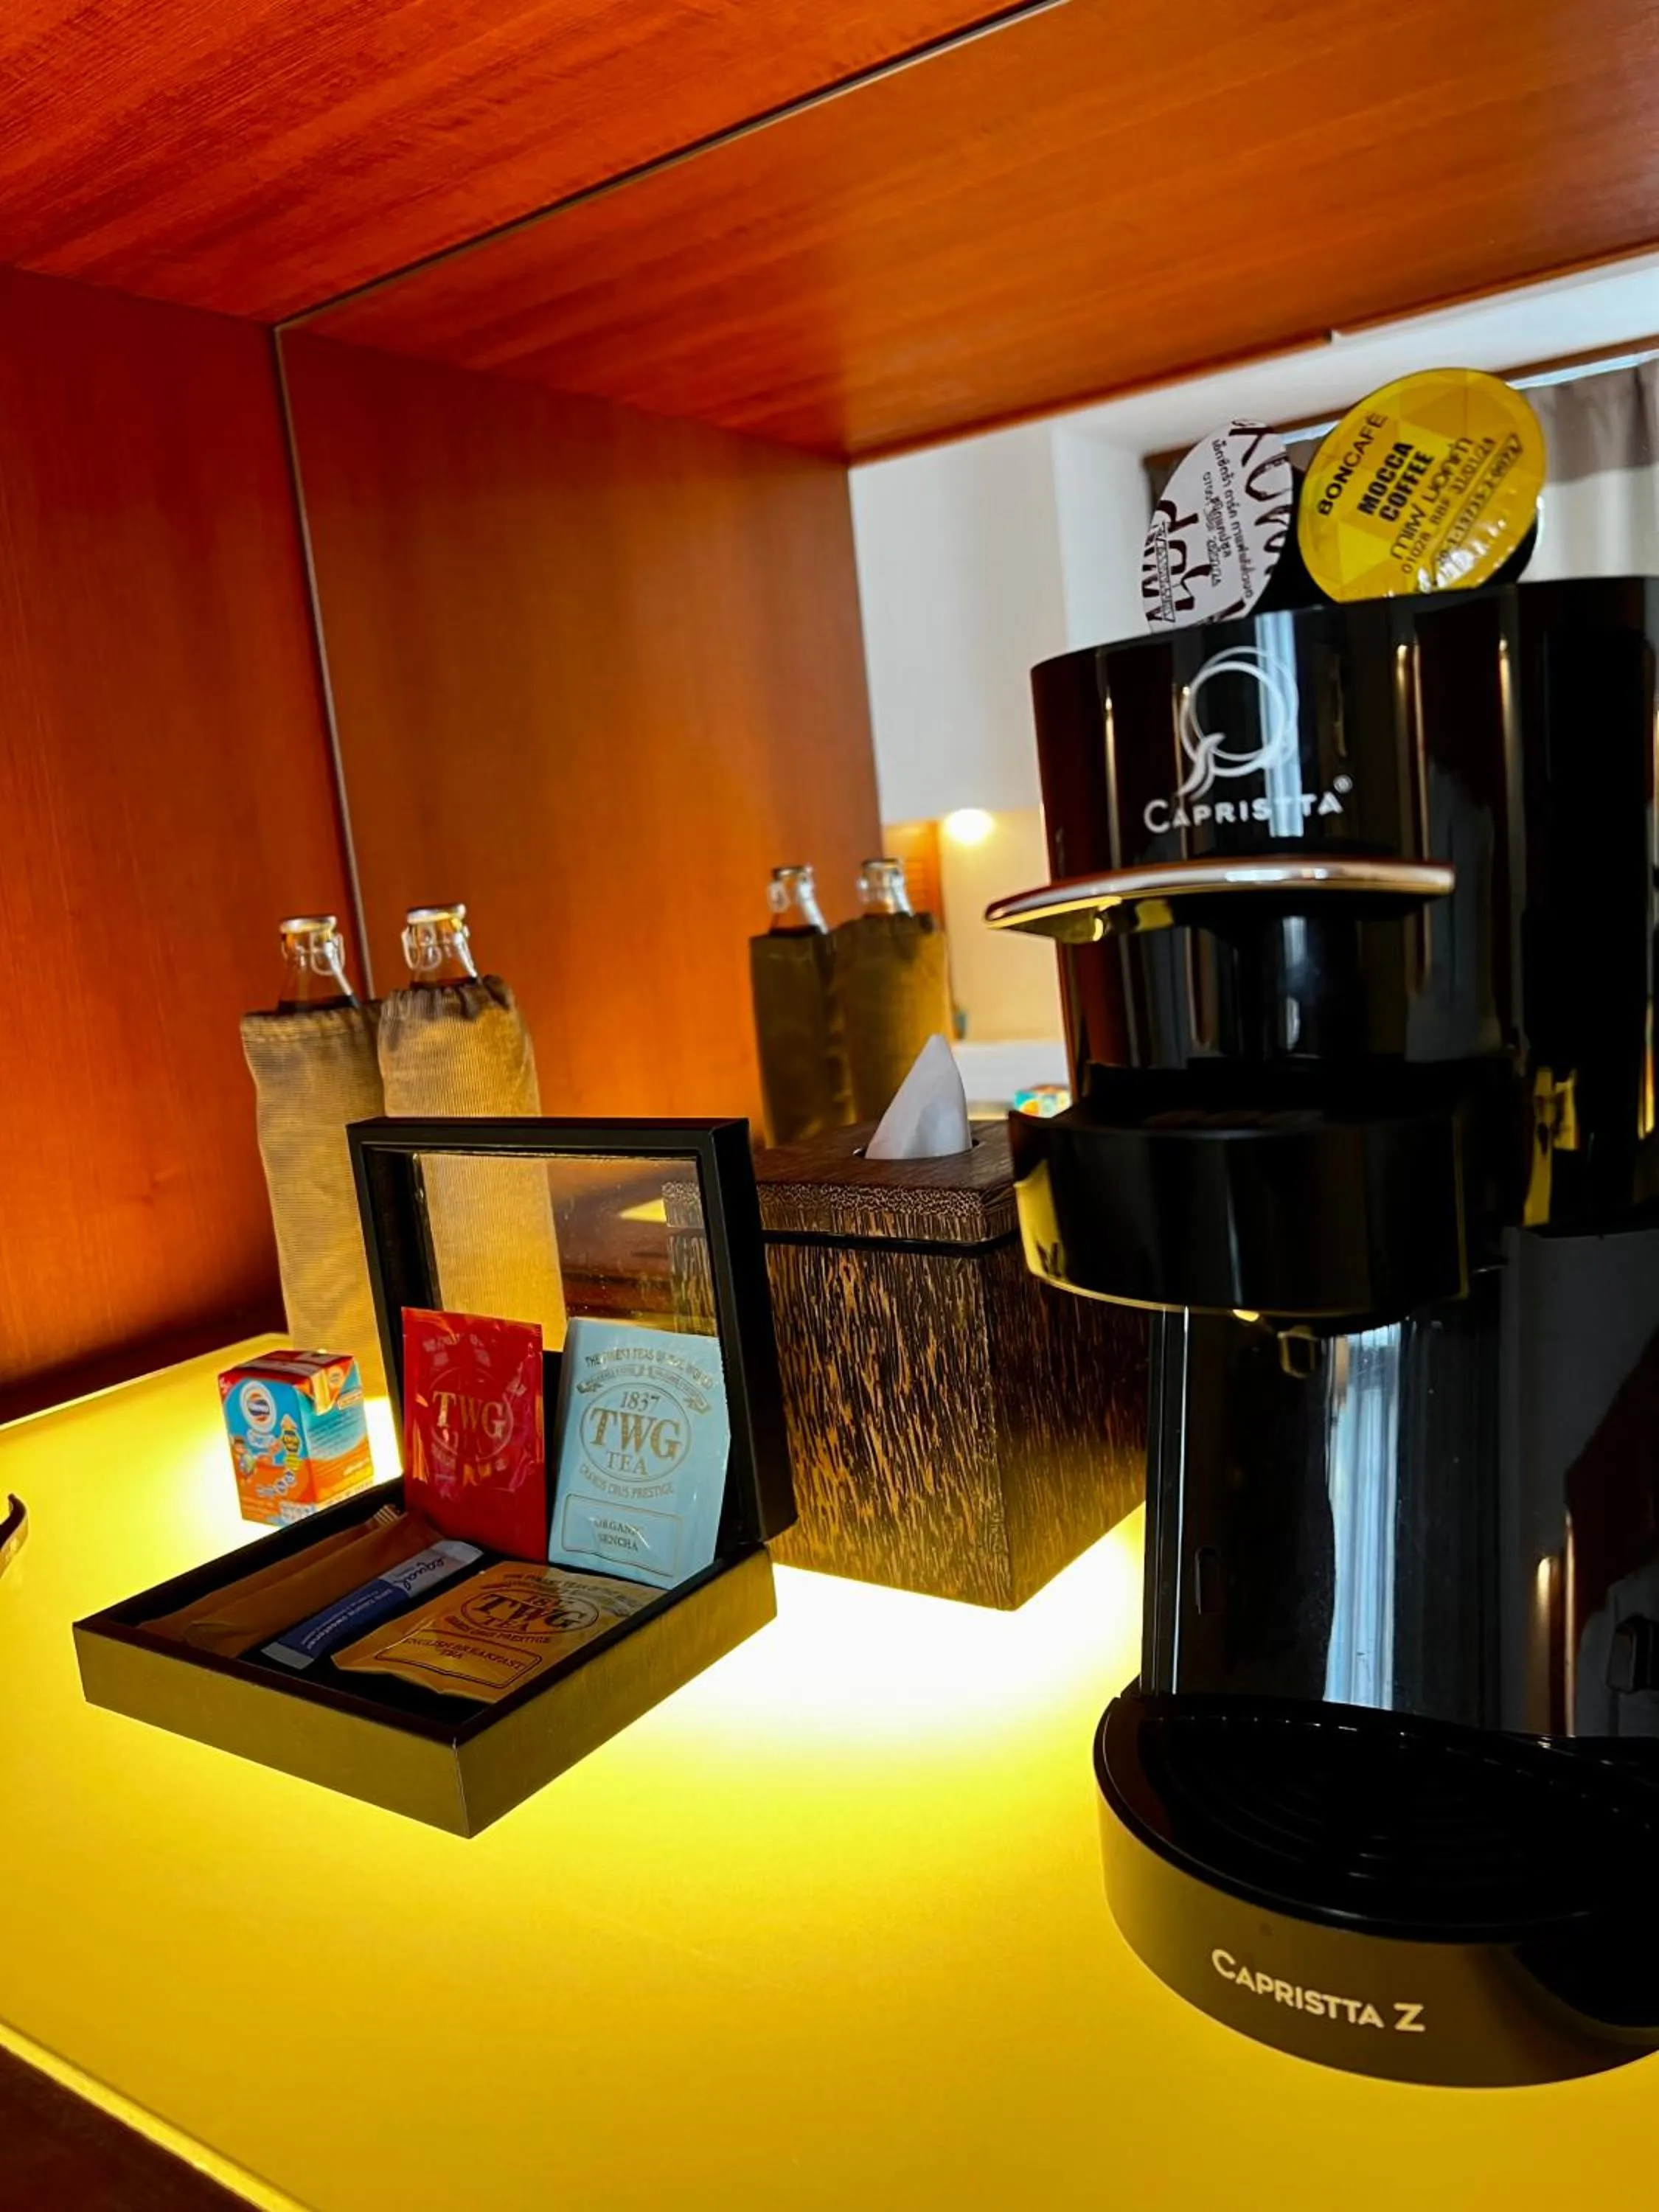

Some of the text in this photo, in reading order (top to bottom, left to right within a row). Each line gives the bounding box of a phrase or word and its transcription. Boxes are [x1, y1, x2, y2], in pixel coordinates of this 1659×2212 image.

[1317, 412, 1388, 516] BONCAFÉ
[1357, 442, 1413, 515] MOCCA
[1378, 451, 1434, 522] COFFEE
[432, 1391, 507, 1439] TWG
[620, 1391, 661, 1413] 1837
[590, 1407, 682, 1461] TWG
[606, 1450, 649, 1475] TEA
[473, 1593, 586, 1629] TWG
[487, 1616, 531, 1632] TEA
[1211, 1949, 1425, 2032] CAPRISTTA Z
